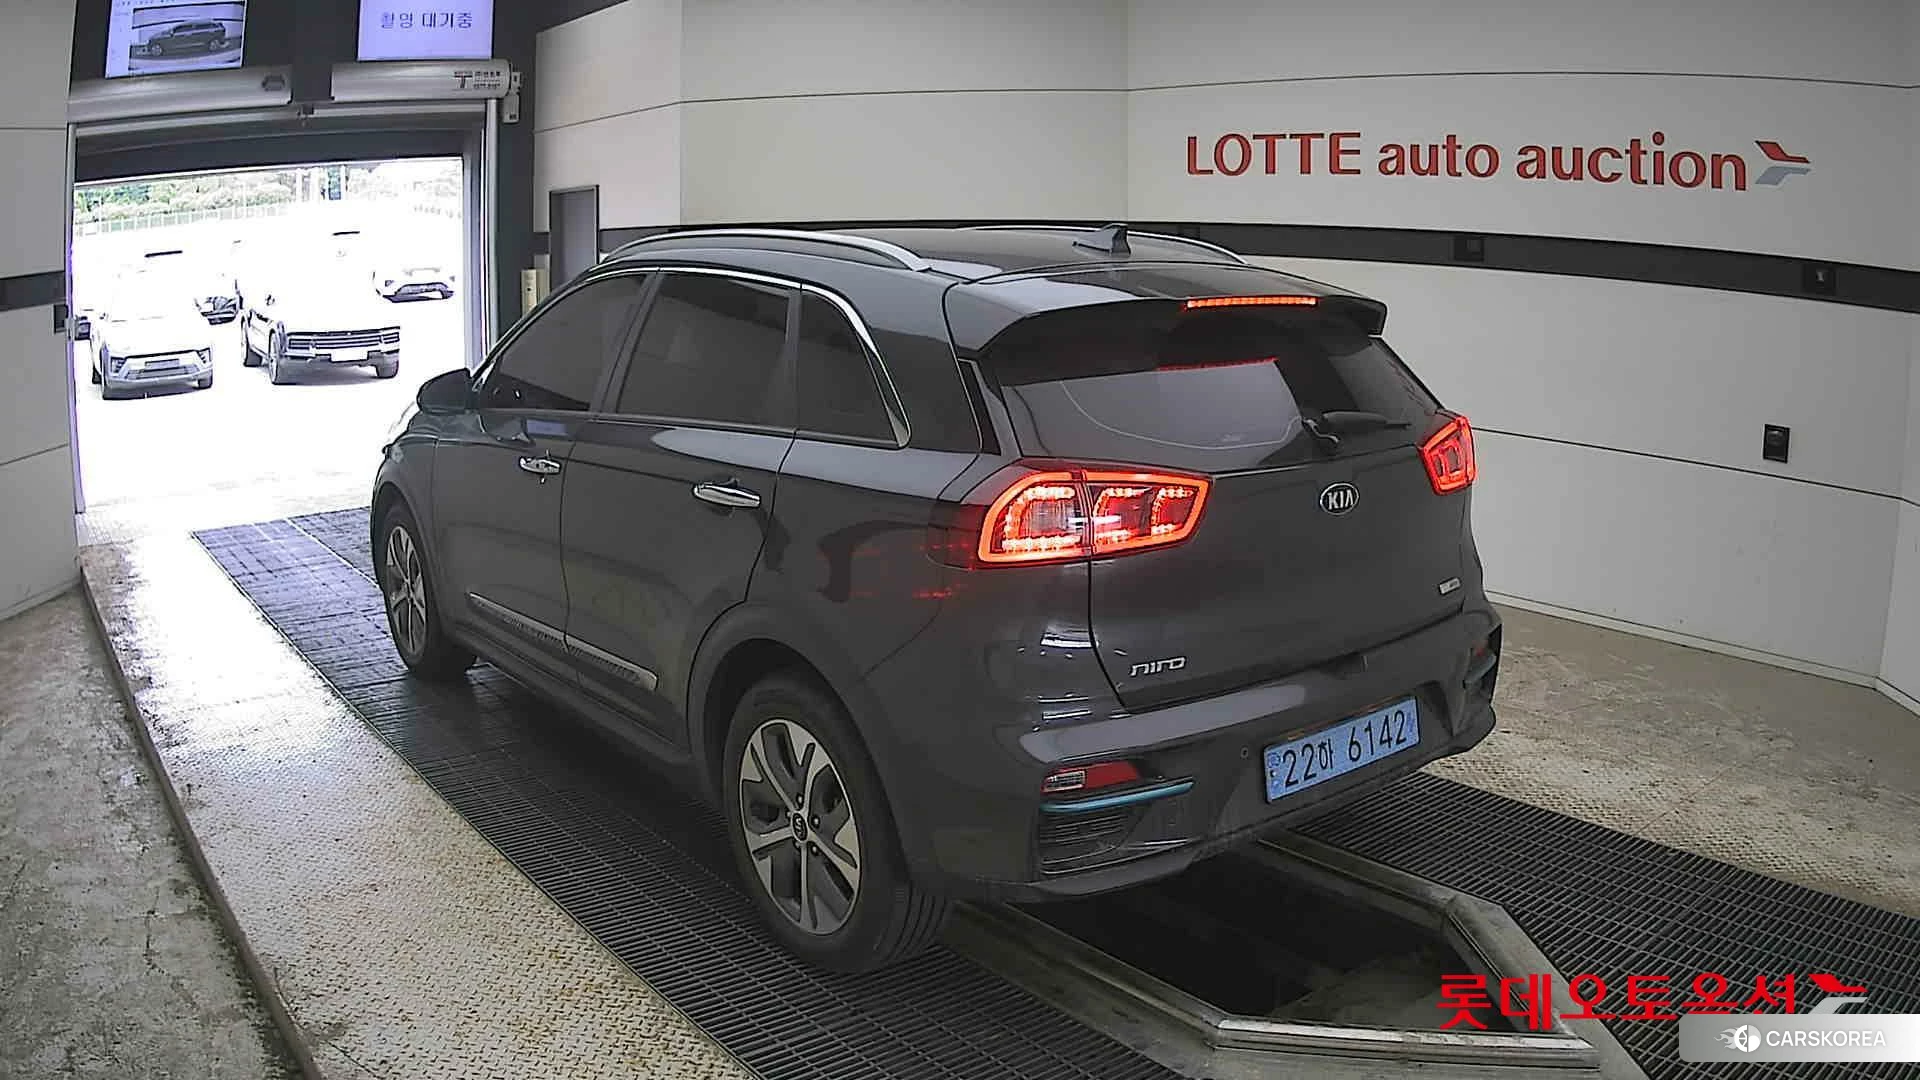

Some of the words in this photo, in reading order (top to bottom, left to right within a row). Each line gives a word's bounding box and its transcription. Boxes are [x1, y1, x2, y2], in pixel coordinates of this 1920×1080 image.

[422, 12, 473, 29] 대기중
[1187, 131, 1362, 176] LOTTE
[1378, 134, 1500, 178] auto
[1516, 131, 1747, 191] auction
[1327, 489, 1354, 510] KIA
[1282, 738, 1334, 788] 22하
[1349, 710, 1407, 762] 6142
